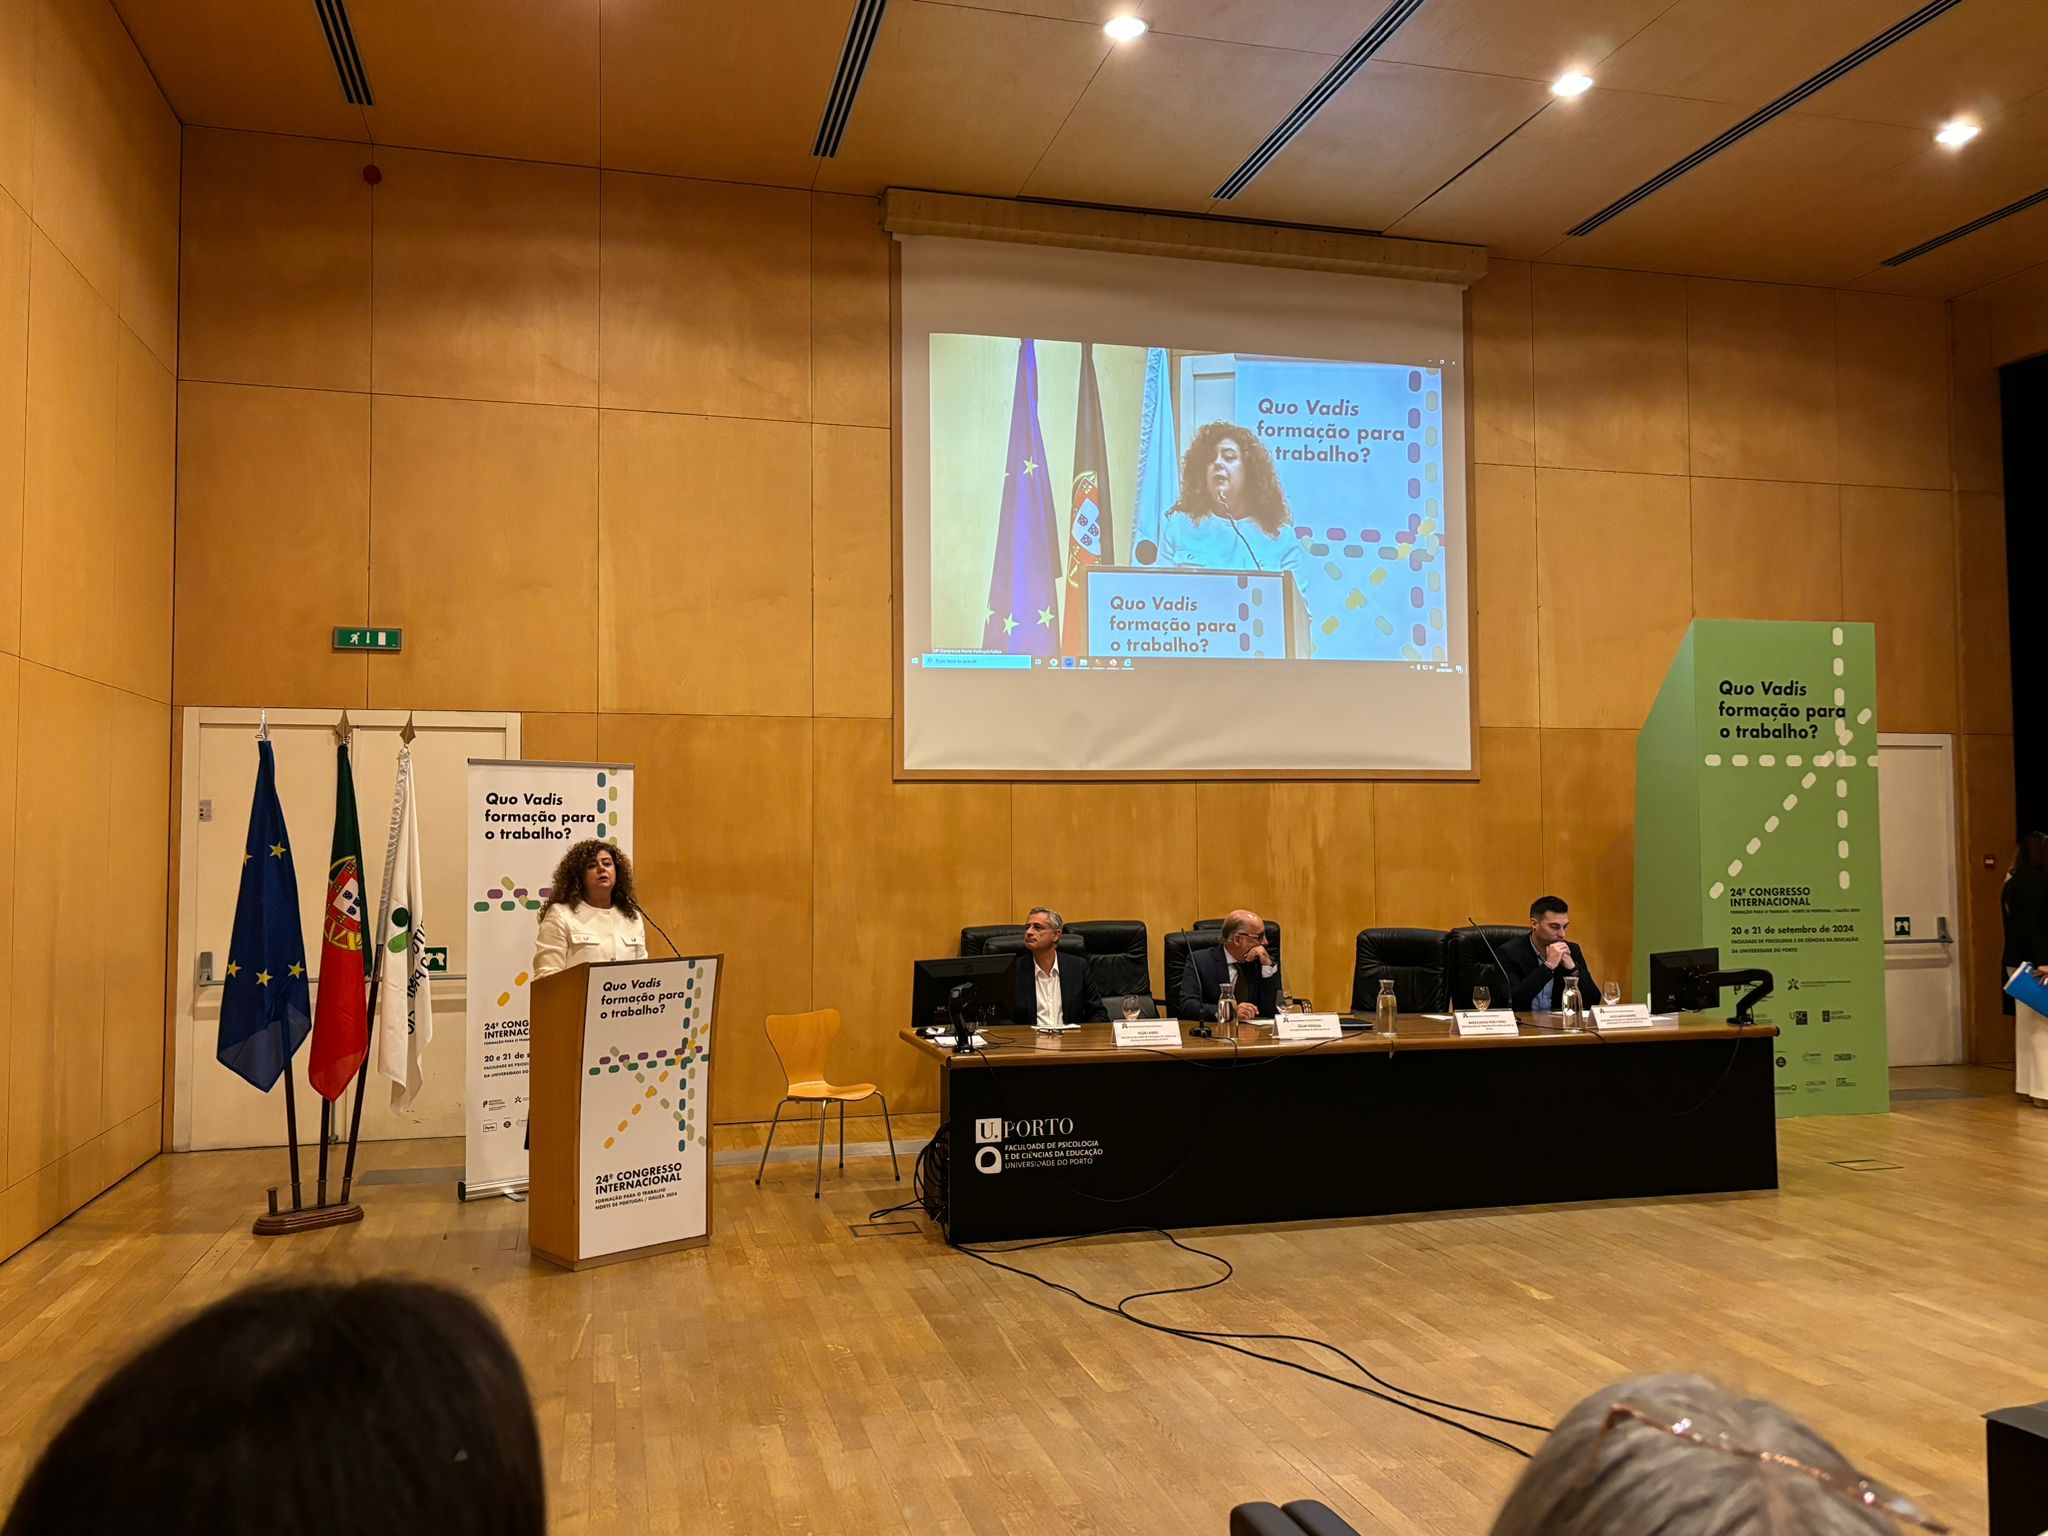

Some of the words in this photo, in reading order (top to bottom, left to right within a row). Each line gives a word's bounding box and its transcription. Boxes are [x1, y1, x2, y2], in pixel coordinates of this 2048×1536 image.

[1258, 398, 1298, 415] Quo
[1306, 399, 1359, 416] Vadis
[1256, 420, 1350, 443] formação
[1357, 428, 1405, 444] para
[1276, 444, 1371, 463] trabalho?
[1110, 596, 1146, 610] Quo
[1152, 596, 1198, 611] Vadis
[1110, 615, 1190, 636] formação
[1197, 622, 1236, 636] para
[1110, 641, 1120, 652] o
[1127, 636, 1208, 652] trabalho?
[1719, 680, 1754, 696] Quo
[1761, 680, 1806, 696] Vadis
[1719, 701, 1800, 722] formação
[1806, 707, 1846, 721] para
[1720, 727, 1730, 738] o
[1736, 723, 1818, 738] trabalho?
[486, 792, 518, 805] Quo
[524, 792, 563, 806] Vadis
[485, 808, 556, 826] formação
[562, 814, 595, 826] para
[485, 830, 494, 839] o
[500, 826, 572, 840] trabalho?
[1749, 887, 1810, 896] CONGRESSO
[1730, 898, 1810, 906] INTERNACIONAL
[1731, 926, 1742, 934] 20
[1752, 926, 1761, 934] 21
[1764, 926, 1775, 934] de
[1778, 925, 1817, 934] setembro
[1819, 924, 1830, 933] de
[1832, 925, 1854, 933] 2024
[603, 982, 626, 992] Quo
[632, 978, 662, 989] Vadis
[601, 992, 654, 1005] formação
[658, 992, 684, 1003] para
[612, 1004, 666, 1018] trabalho?
[502, 1020, 529, 1029] CONG
[484, 1028, 529, 1039] INTERNAC
[1003, 1117, 1074, 1138] PORTO
[1005, 1142, 1045, 1152] FACULDADE
[1058, 1140, 1098, 1148] PSICOLOGIA
[1022, 1150, 1053, 1158] CIÊNCIAS
[1066, 1148, 1103, 1157] EDUCAÇÃO
[1005, 1160, 1056, 1169] UNIVERSIDADE
[596, 1174, 614, 1184] 24º
[616, 1162, 682, 1181] CONGRESSO
[596, 1172, 682, 1195] INTERNACIONAL
[595, 1195, 622, 1204] FORMAÇÃO
[642, 1188, 666, 1196] TRABALHO
[620, 1198, 643, 1206] PORTUGAL
